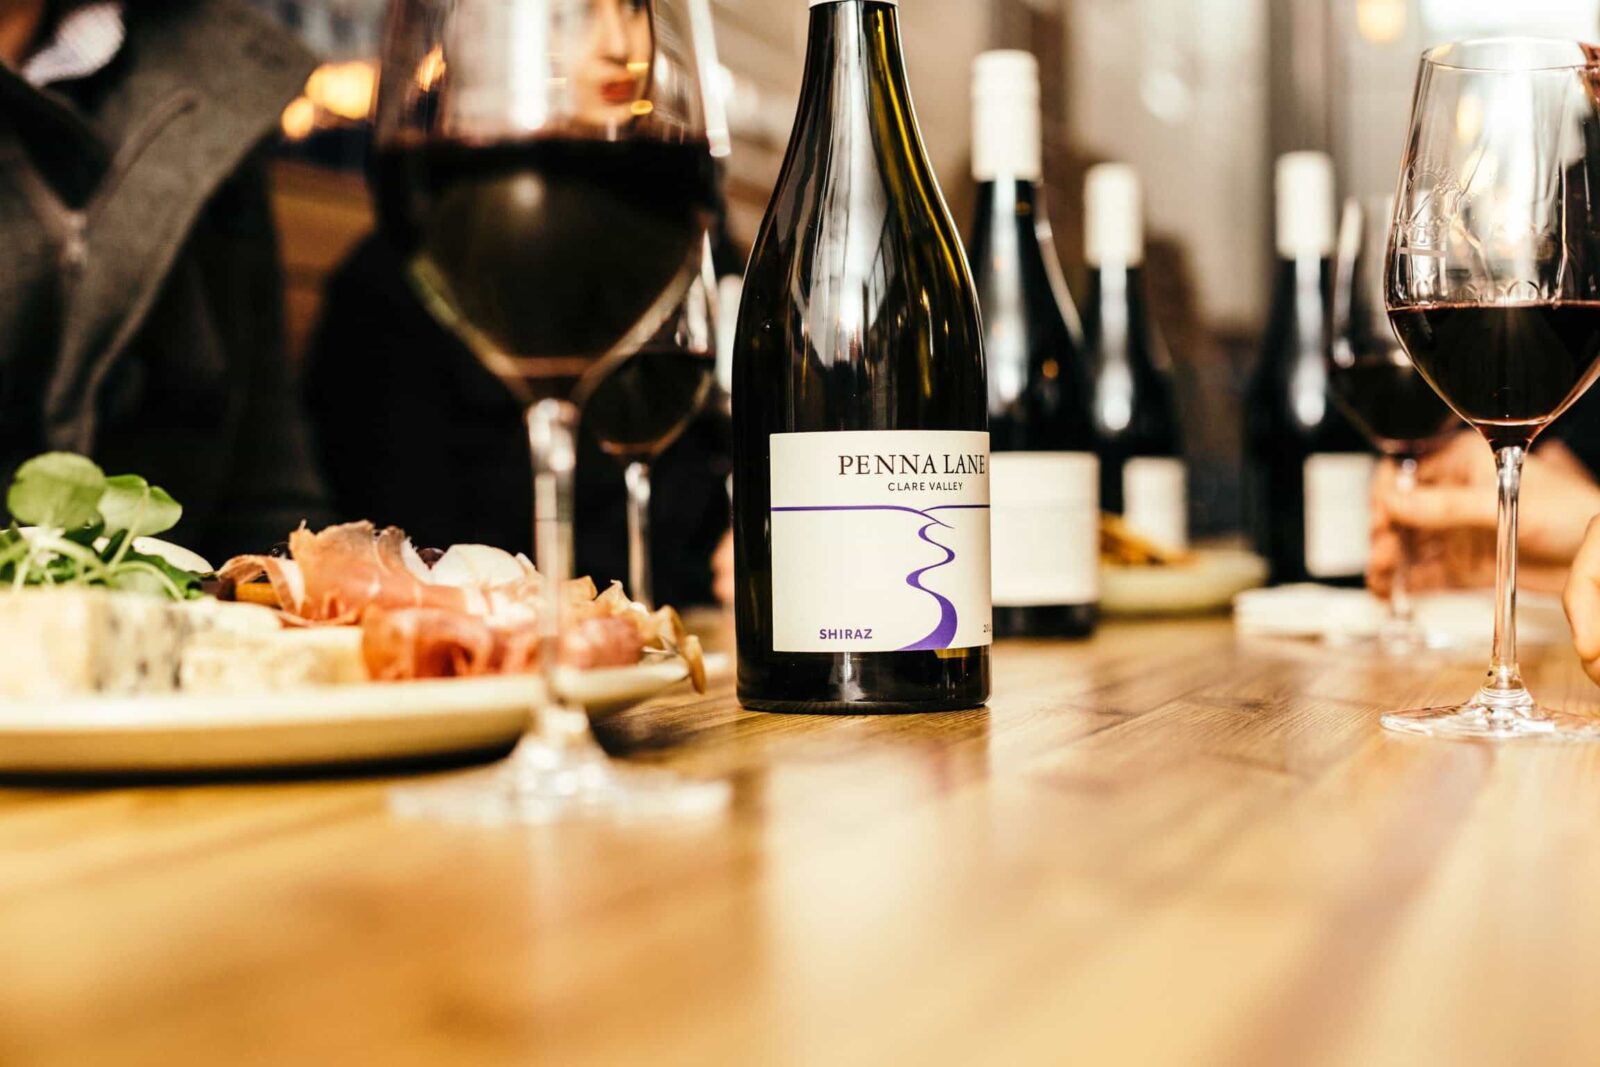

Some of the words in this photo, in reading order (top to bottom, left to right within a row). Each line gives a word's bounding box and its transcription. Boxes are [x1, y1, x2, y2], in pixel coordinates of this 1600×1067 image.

[838, 454, 938, 475] PENNA
[943, 454, 985, 474] LANE
[888, 482, 925, 491] CLARE
[929, 482, 963, 491] VALLEY
[819, 628, 873, 640] SHIRAZ
